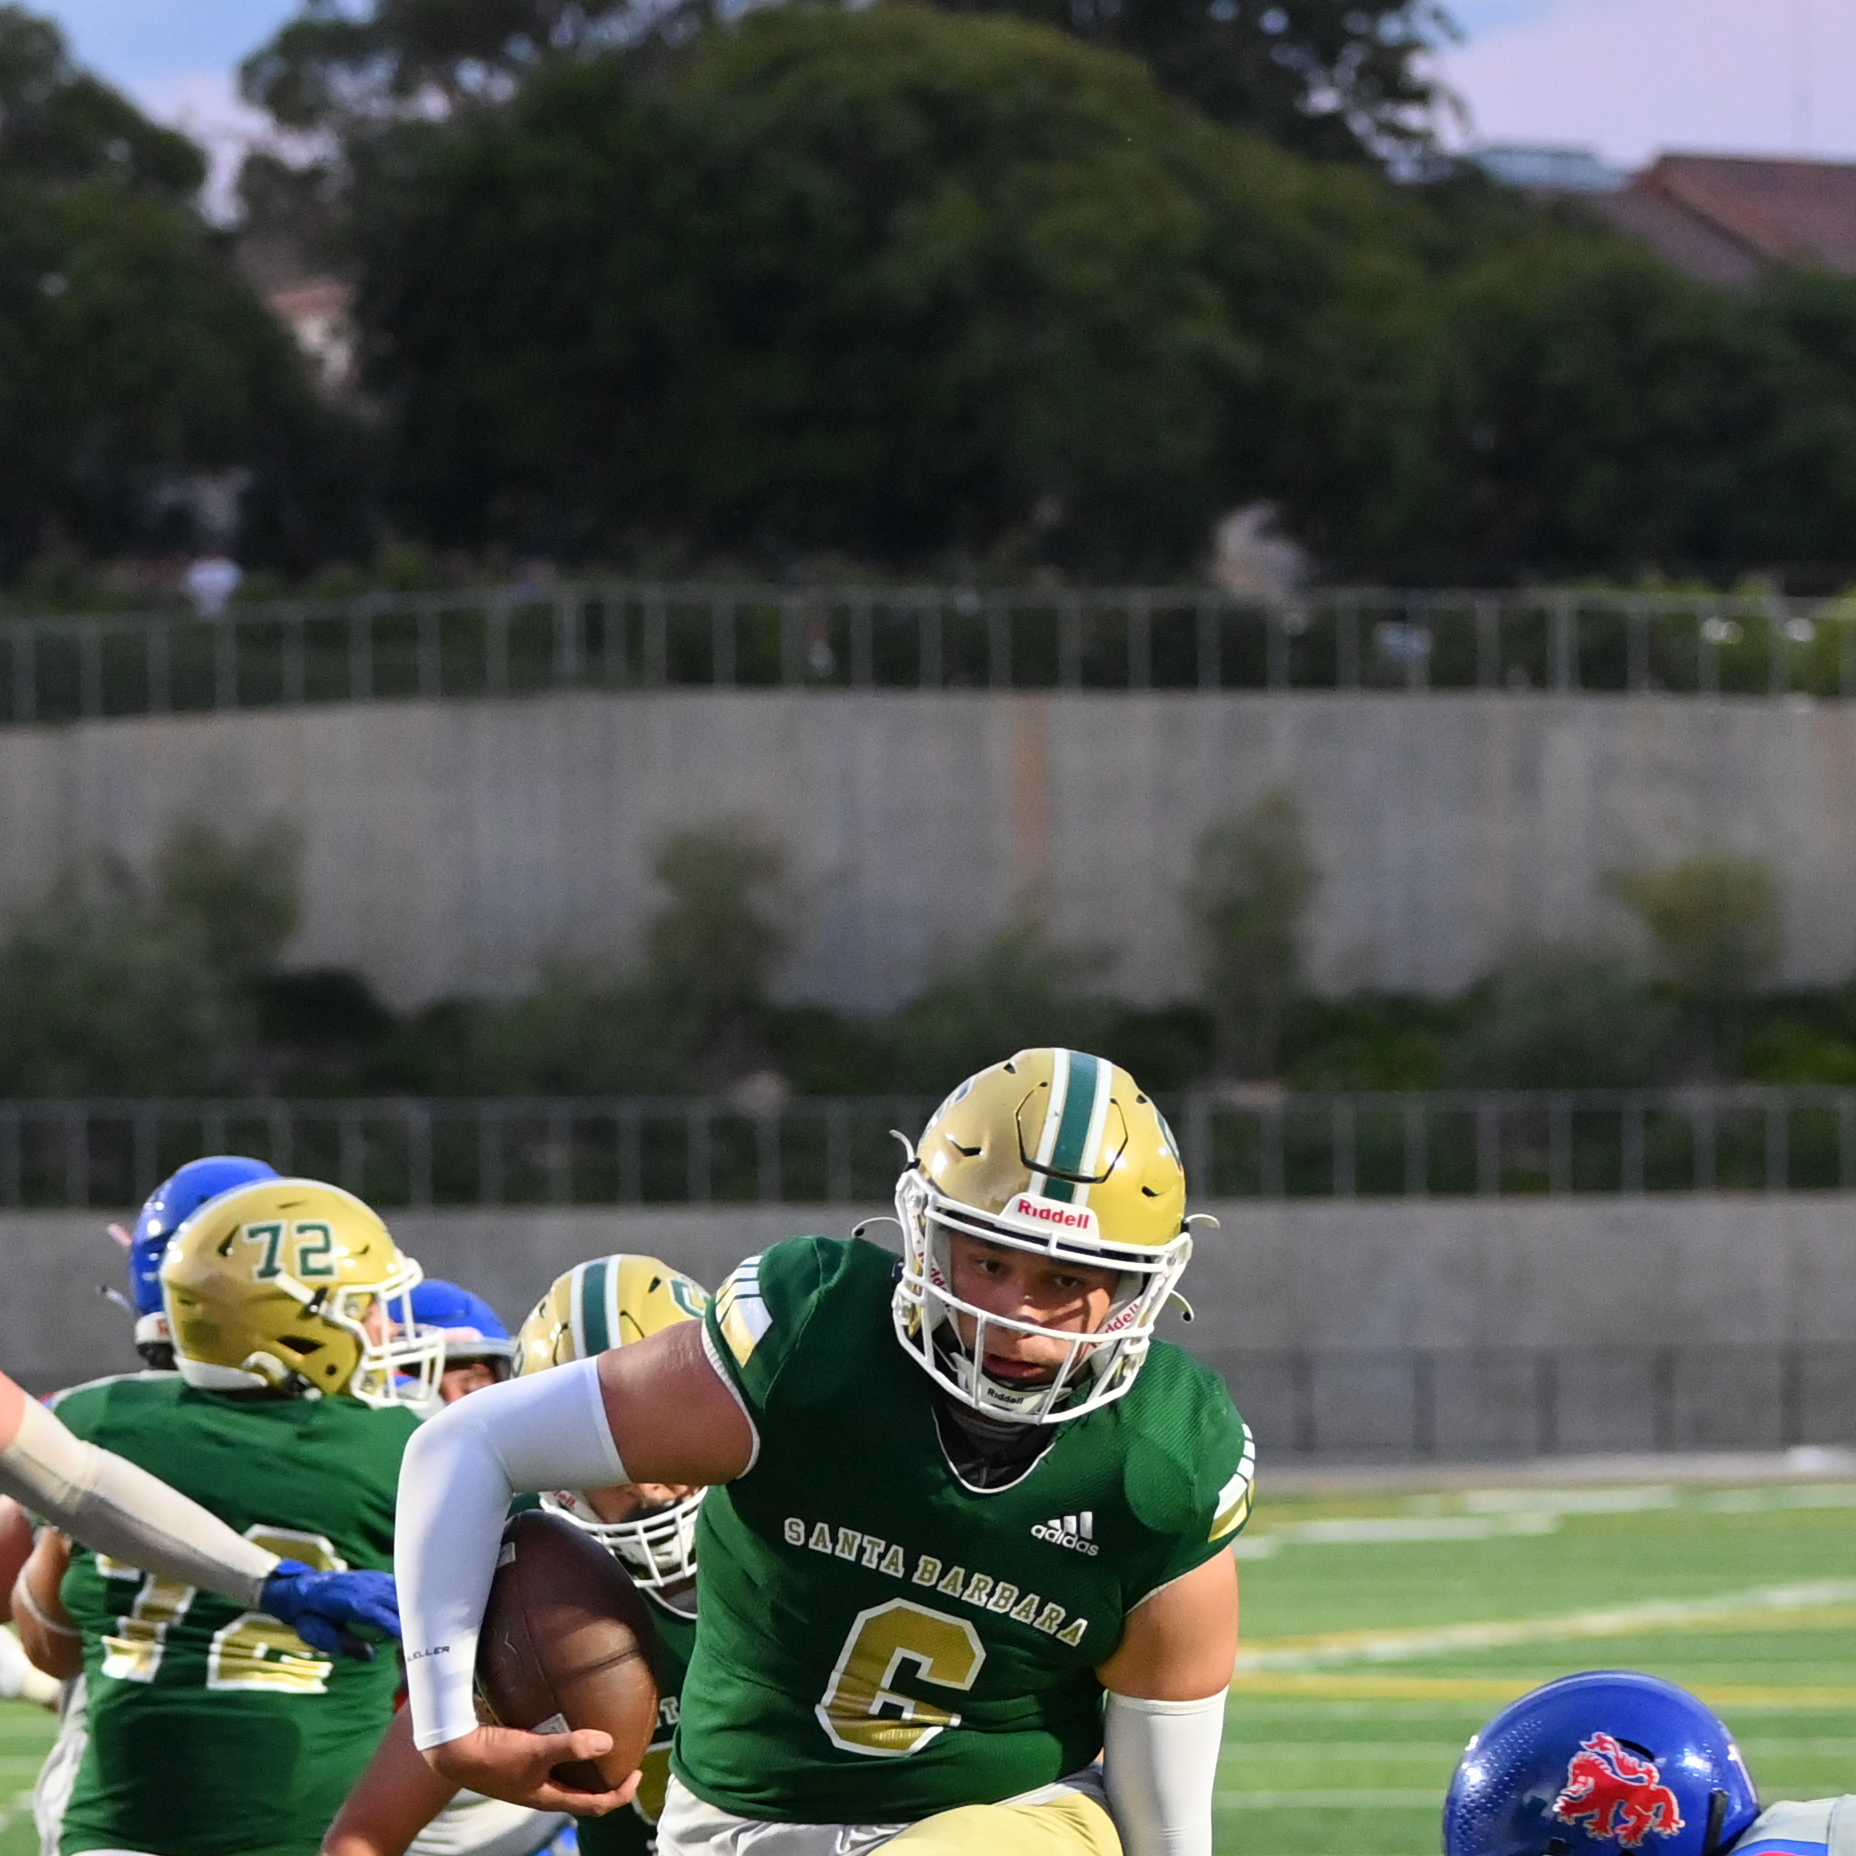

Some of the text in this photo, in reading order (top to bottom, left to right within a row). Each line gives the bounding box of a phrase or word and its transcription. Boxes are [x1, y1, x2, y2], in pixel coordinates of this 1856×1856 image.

[1017, 1198, 1091, 1231] Riddell
[241, 1219, 339, 1284] 72
[986, 1387, 1025, 1406] Riddell
[1030, 1521, 1100, 1557] adidas
[95, 1523, 349, 1695] 72
[783, 1516, 1089, 1648] SANTA BARBARA
[814, 1596, 987, 1758] 6
